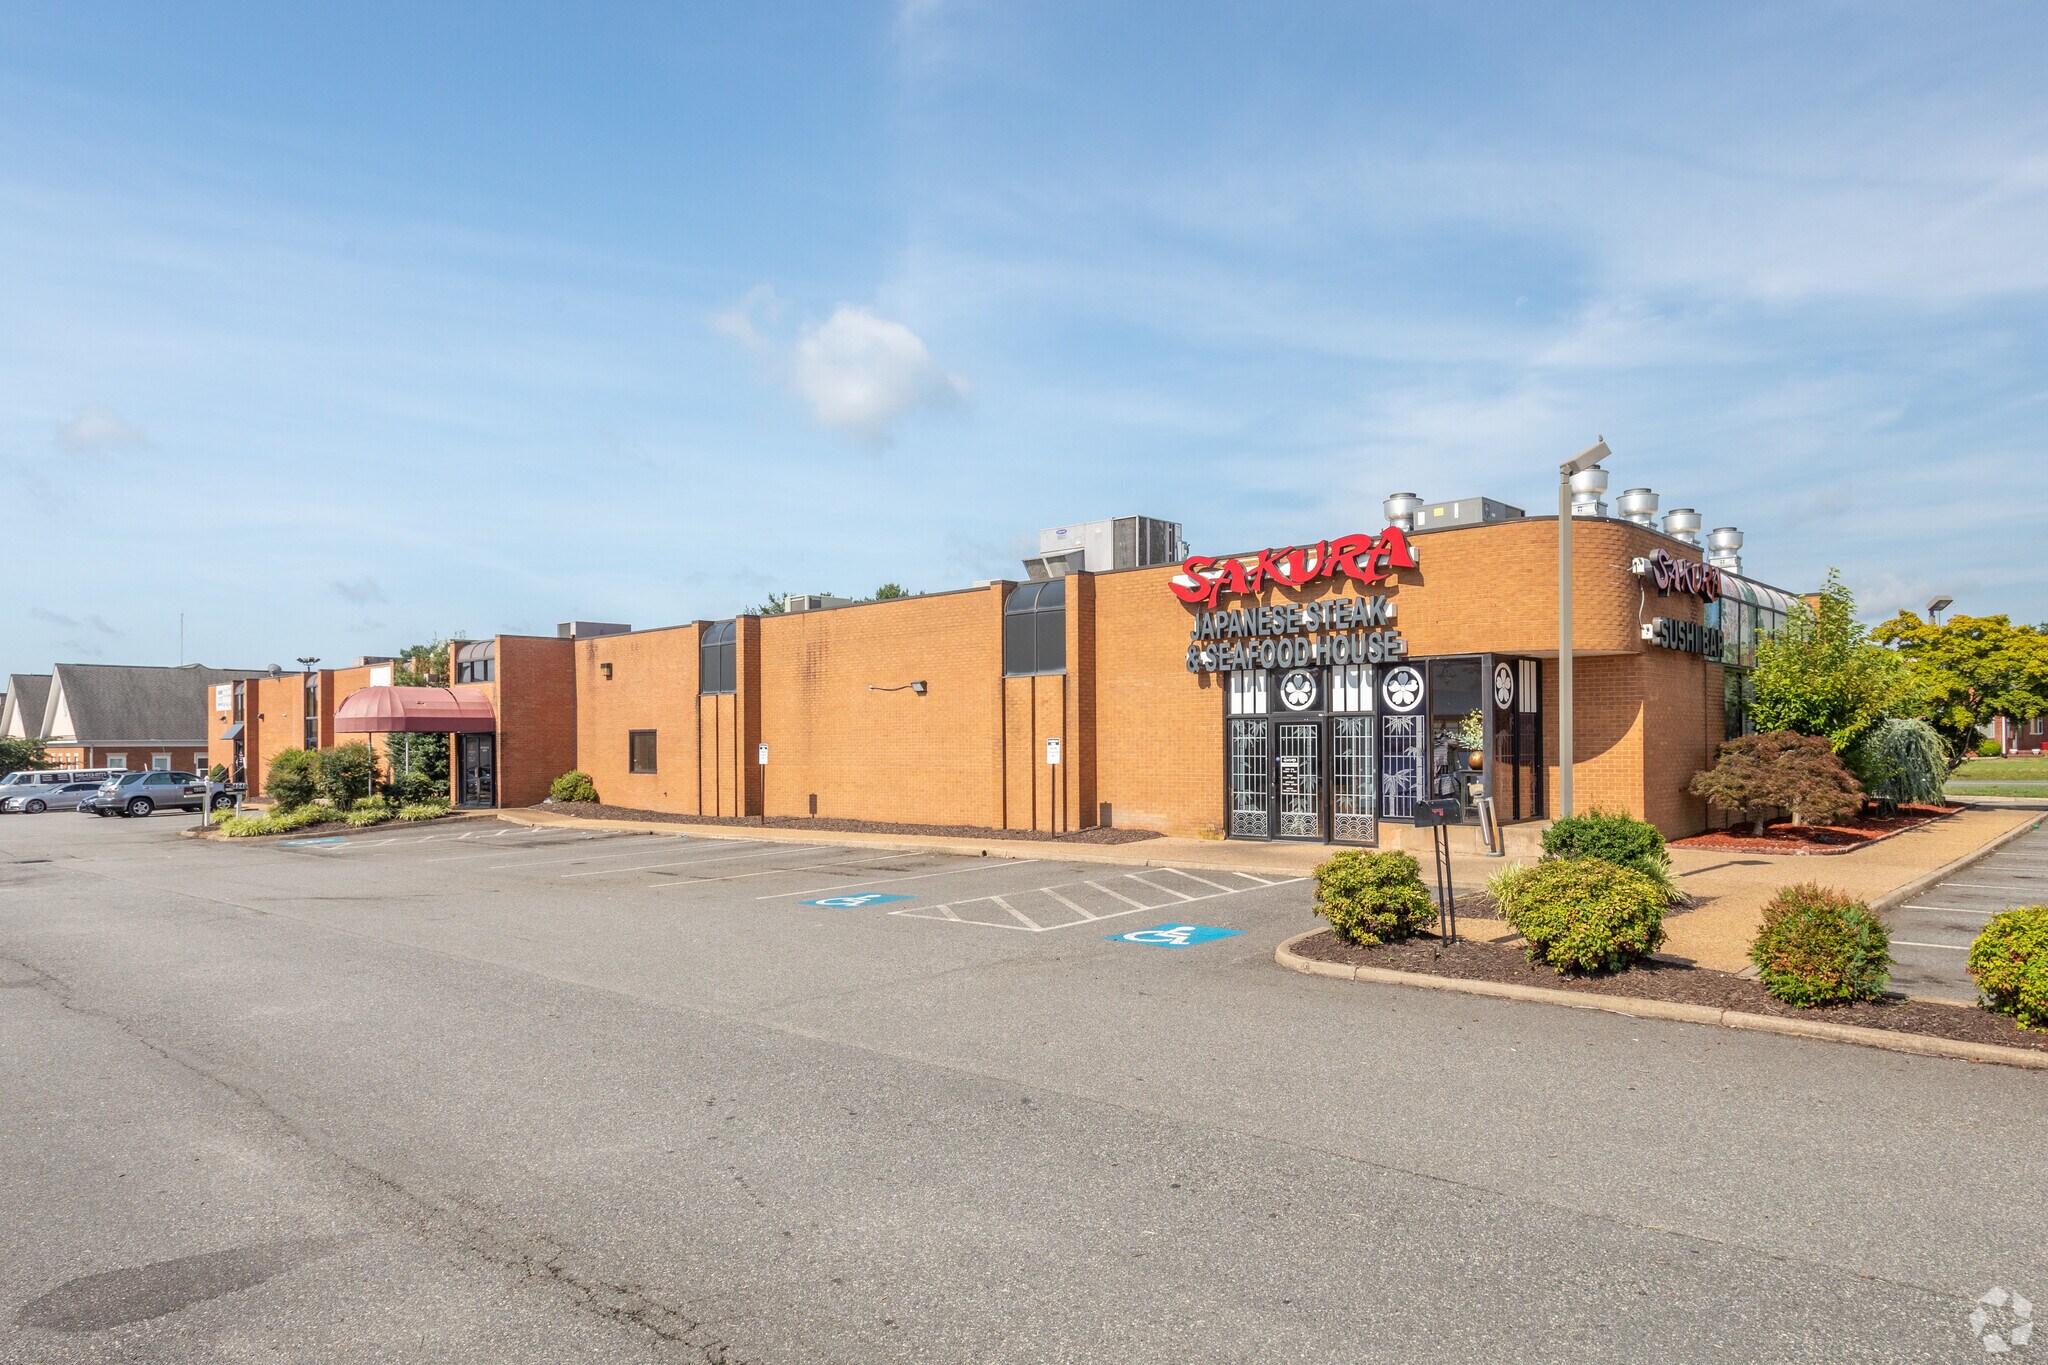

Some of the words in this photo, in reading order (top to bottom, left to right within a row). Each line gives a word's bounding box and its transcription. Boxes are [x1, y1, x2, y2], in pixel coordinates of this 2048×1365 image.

[1168, 525, 1416, 608] SAKURA
[1190, 603, 1300, 640] JAPANESE
[1306, 595, 1387, 632] STEAK
[1660, 617, 1700, 653] SUSHI
[1702, 625, 1725, 658] BAR
[1186, 645, 1200, 673] &
[1205, 636, 1310, 672] SEAFOOD
[1316, 630, 1399, 665] HOUSE
